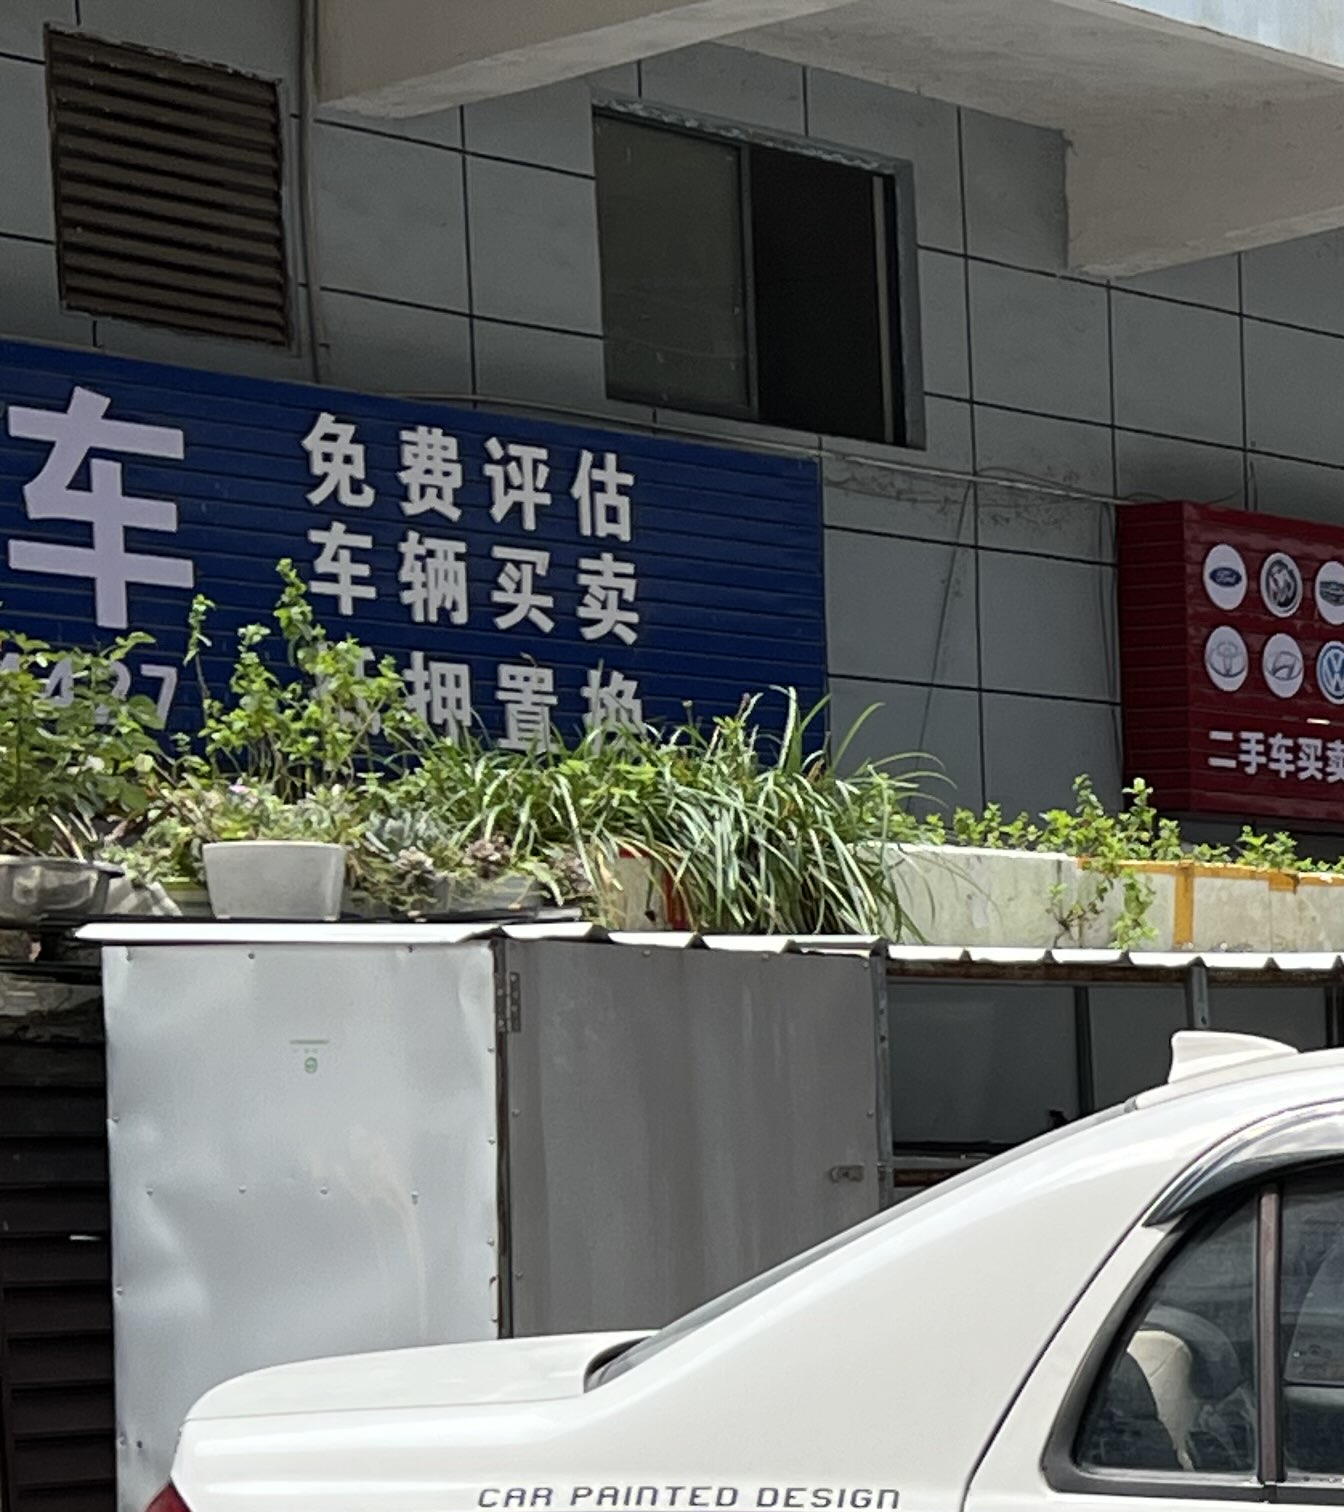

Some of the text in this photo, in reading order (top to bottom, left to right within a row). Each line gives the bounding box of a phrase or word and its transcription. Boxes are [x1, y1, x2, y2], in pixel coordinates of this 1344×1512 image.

[9, 386, 194, 630] 车
[302, 412, 636, 544] 免费评估
[308, 521, 641, 646] 车辆买卖
[476, 1485, 901, 1510] CAR PAINTED DESIGN
